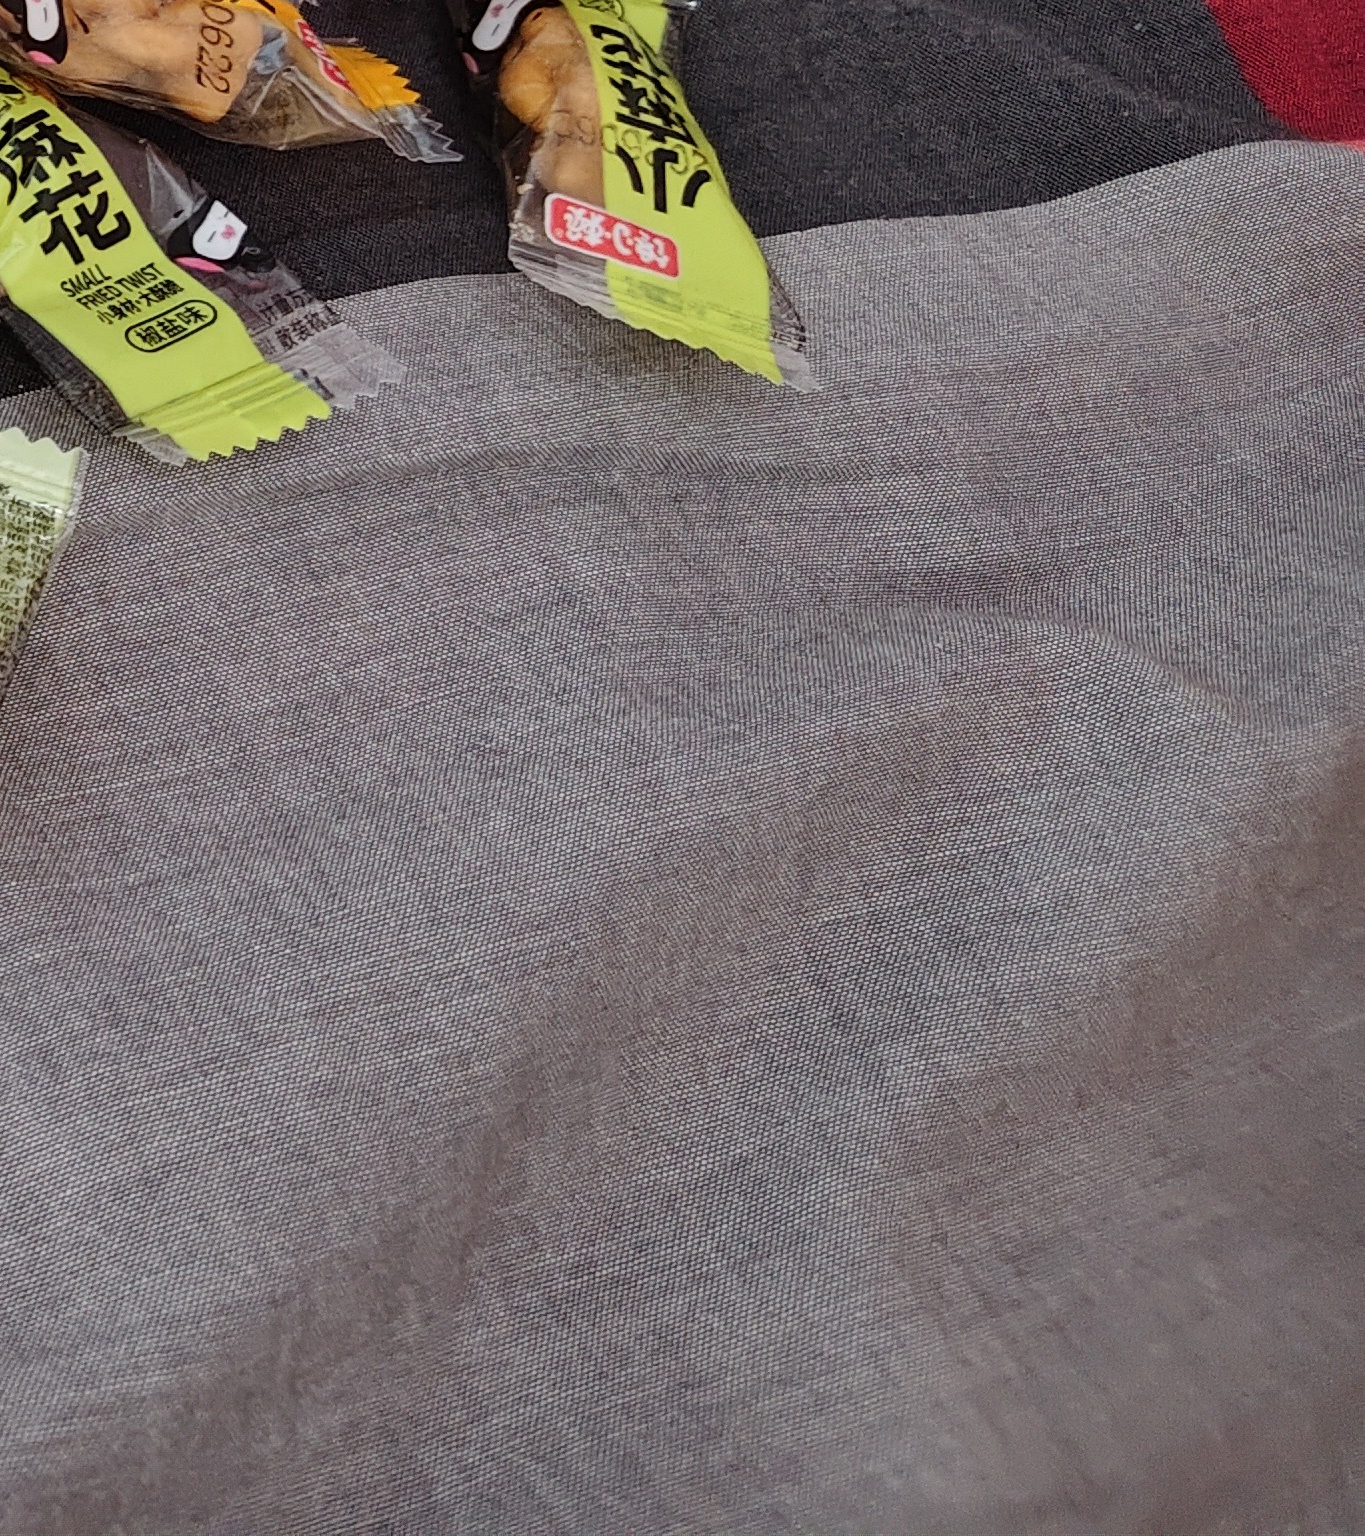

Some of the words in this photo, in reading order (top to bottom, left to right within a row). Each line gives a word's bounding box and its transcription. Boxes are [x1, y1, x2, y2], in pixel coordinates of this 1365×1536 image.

[60, 264, 109, 299] SMALL
[76, 281, 122, 313] FRIED
[118, 263, 164, 296] TWIST
[134, 305, 209, 349] 椒盐味
